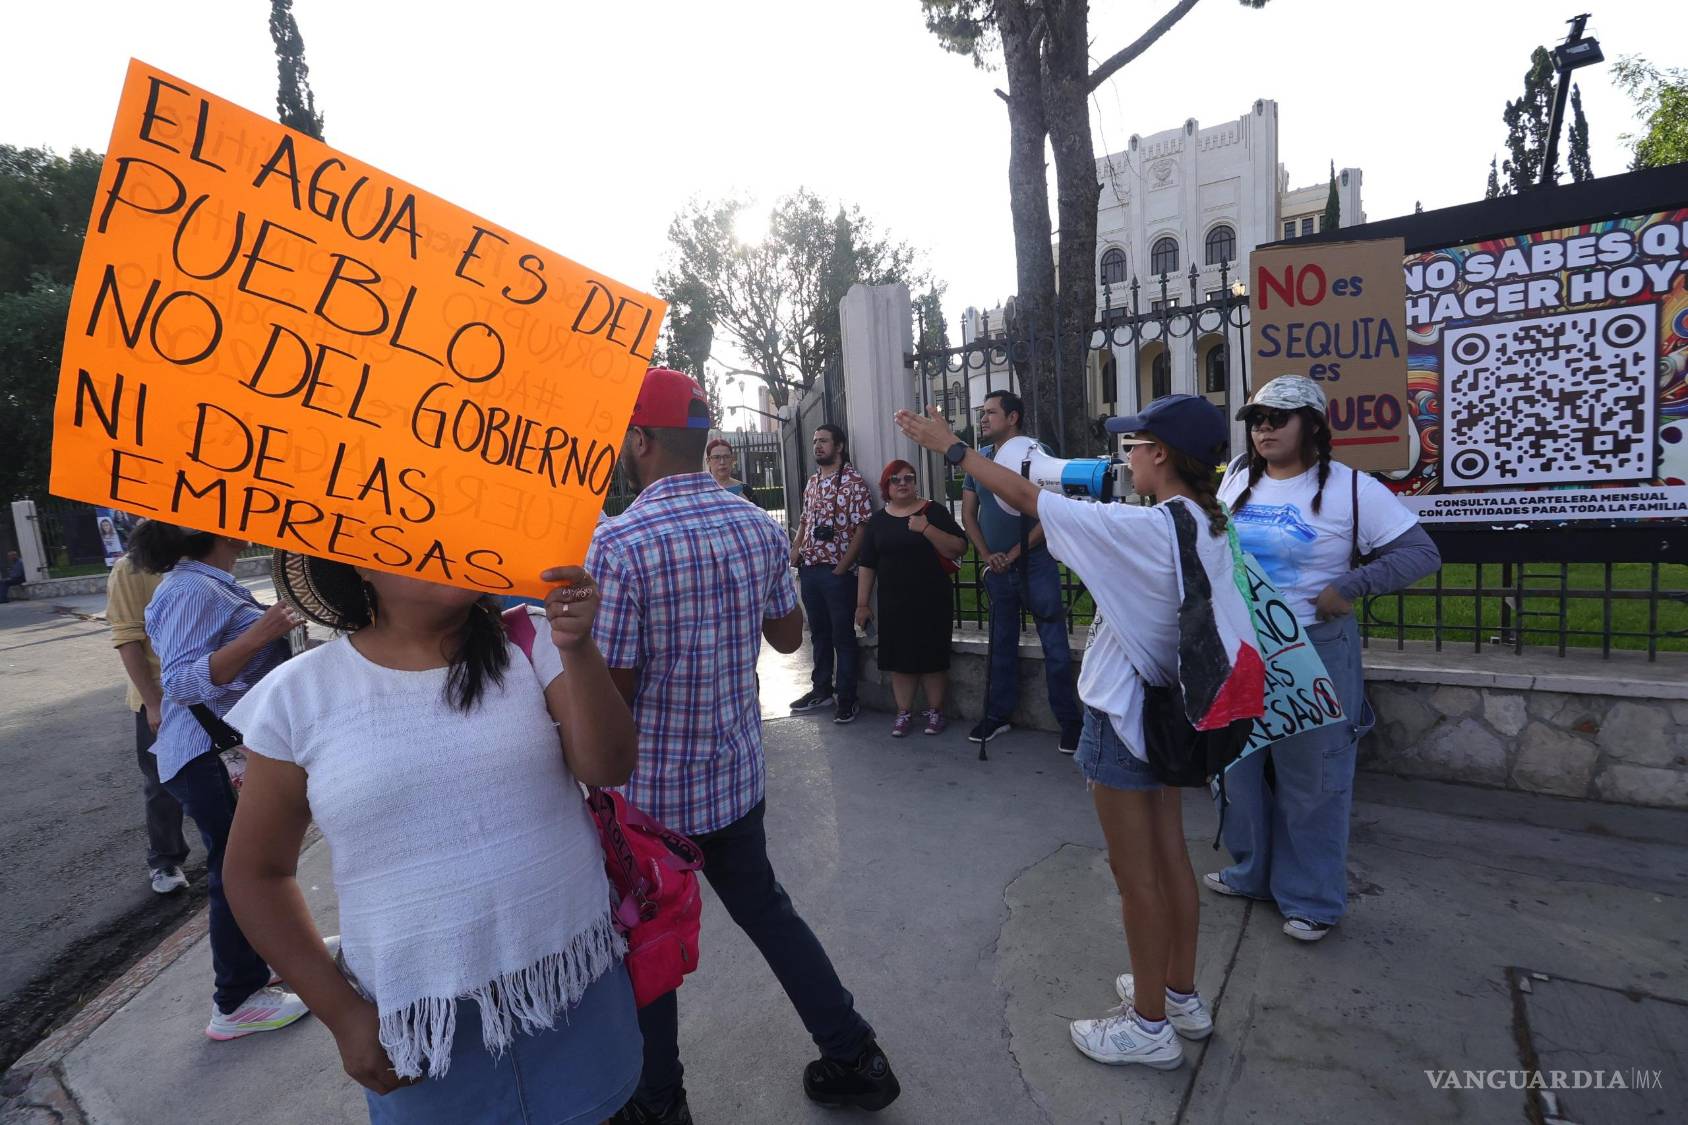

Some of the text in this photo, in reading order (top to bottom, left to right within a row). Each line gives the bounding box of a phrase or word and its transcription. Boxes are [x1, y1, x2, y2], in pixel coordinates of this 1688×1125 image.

[138, 75, 652, 361] EL AGUA ES DEL
[97, 156, 506, 383] PUEBLO
[1465, 231, 1632, 283] SABES
[1258, 264, 1363, 310] NO es
[1406, 279, 1559, 325] HACER
[1257, 317, 1400, 359] SEQUIA
[86, 264, 223, 366] NO
[239, 322, 382, 428] DEL
[411, 382, 620, 497] GOBIERNO
[1309, 363, 1341, 381] es
[73, 368, 435, 523] NI DE LAS
[109, 448, 513, 590] EMPRESAS
[1418, 501, 1688, 517] CON ACTIVIDADES PARA TODA LA FAMILIA
[1435, 491, 1668, 508] CONSULTA LA CARTELERA MENSUAL
